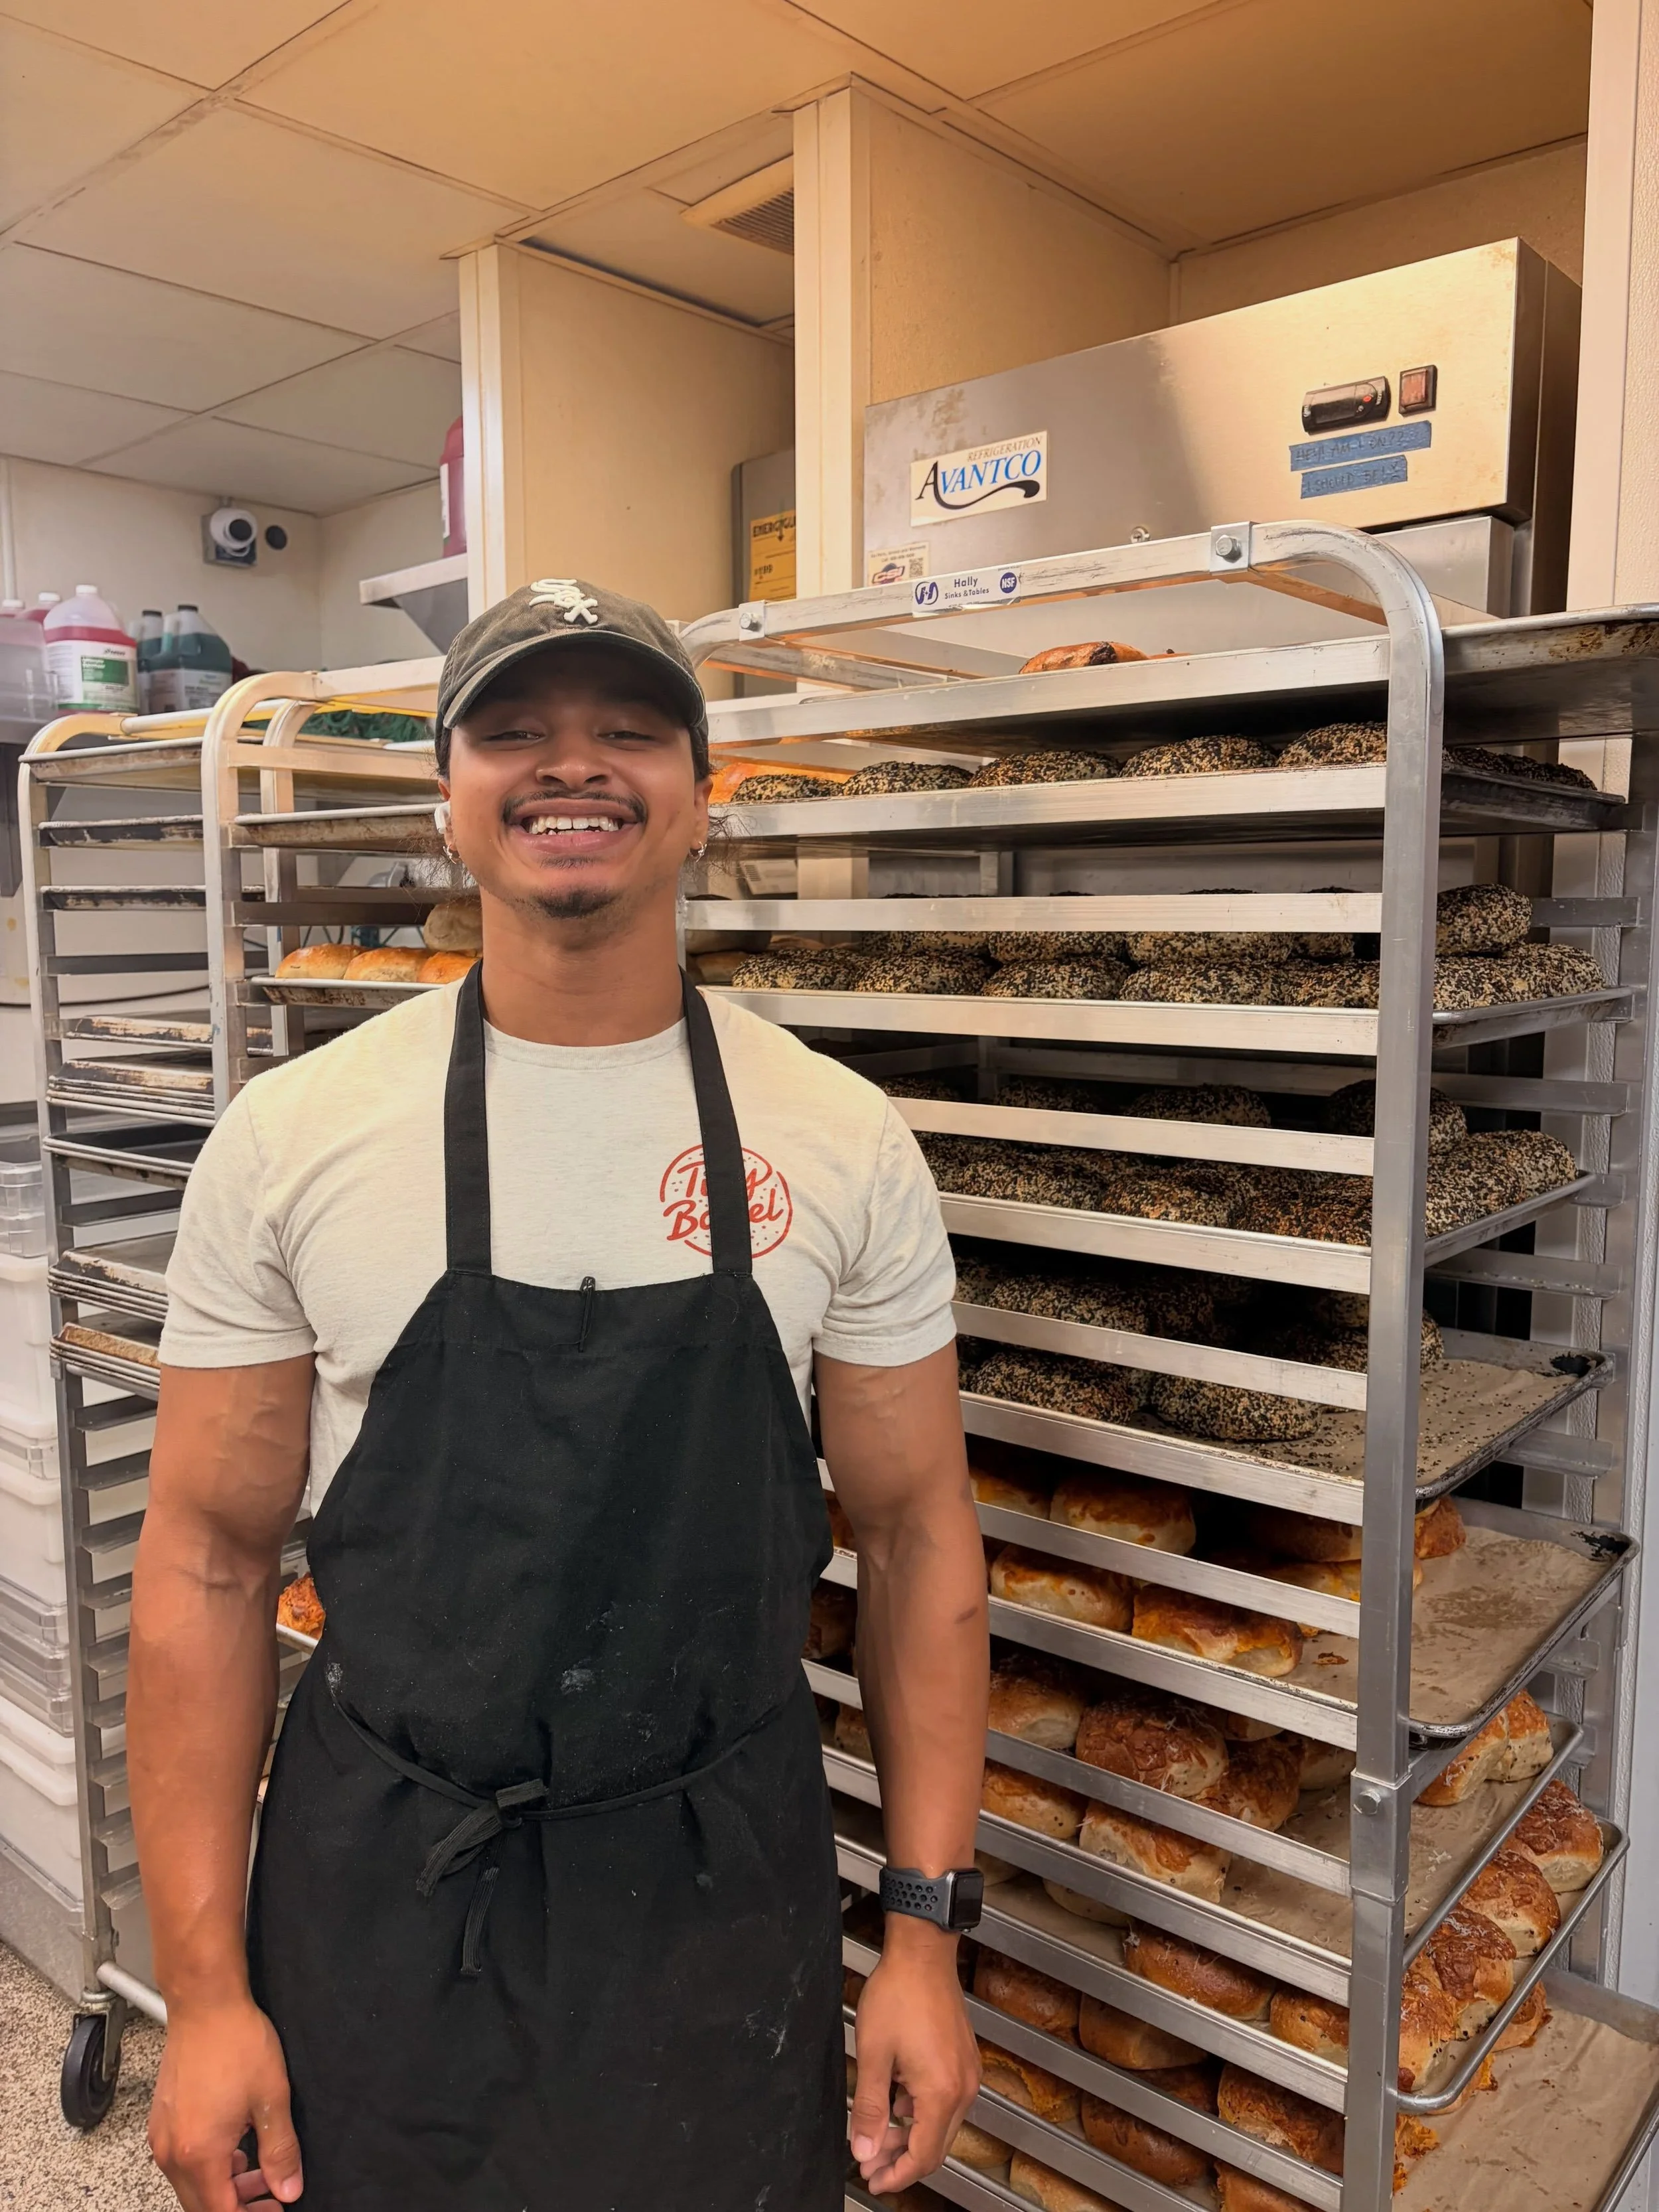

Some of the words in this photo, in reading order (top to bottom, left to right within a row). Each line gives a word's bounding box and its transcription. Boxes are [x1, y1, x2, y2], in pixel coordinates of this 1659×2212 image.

[968, 436, 1042, 462] REFRIGERATION
[915, 449, 1041, 510] AVANTCO
[954, 576, 978, 589] Hally
[1001, 577, 1015, 589] NSF
[945, 591, 962, 599] Sinks
